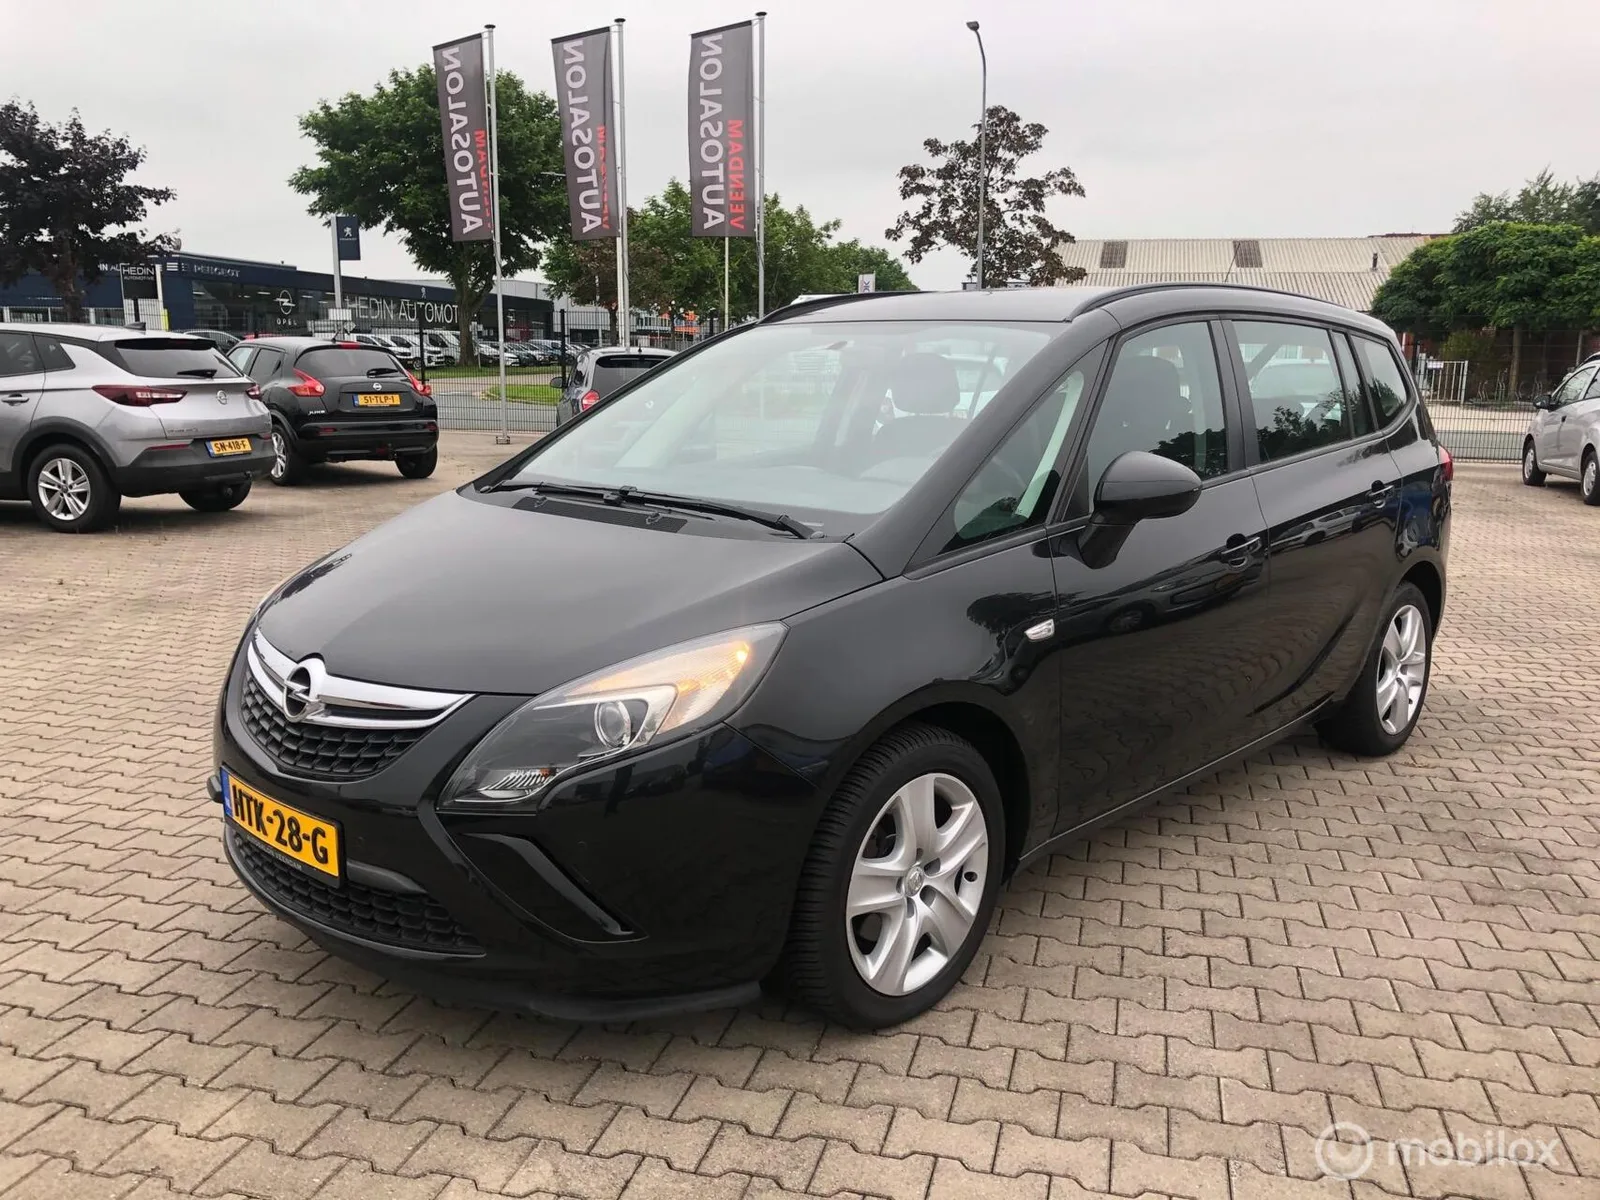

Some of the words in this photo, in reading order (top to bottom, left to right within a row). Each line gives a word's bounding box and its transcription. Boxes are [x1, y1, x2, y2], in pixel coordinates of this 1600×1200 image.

[122, 266, 155, 276] HEDIN
[345, 295, 394, 320] HEDIN
[399, 298, 459, 324] AUTOMOT
[276, 317, 298, 326] OPEL
[363, 395, 395, 404] 51-TLP-1
[214, 442, 248, 453] SN-418-F
[232, 785, 328, 865] HTK-28-G
